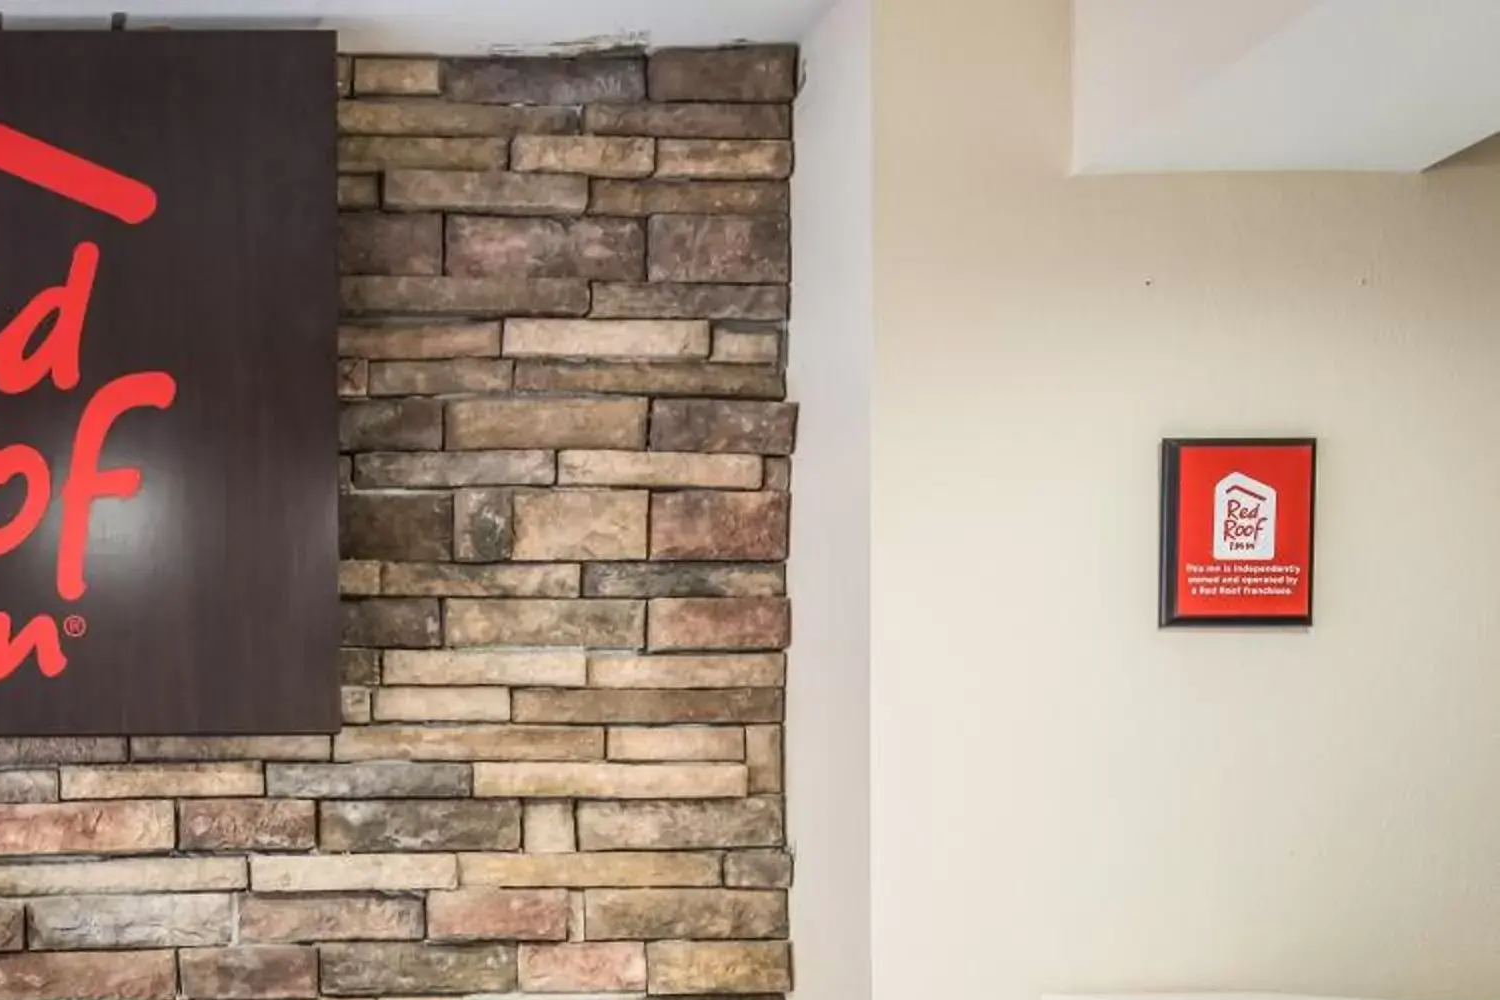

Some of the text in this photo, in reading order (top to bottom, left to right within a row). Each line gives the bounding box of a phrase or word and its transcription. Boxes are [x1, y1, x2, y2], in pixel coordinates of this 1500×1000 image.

[1227, 499, 1260, 520] Red
[1223, 518, 1268, 542] Roof
[1233, 564, 1300, 575] independently
[1187, 576, 1299, 585] owned and operated by
[1199, 586, 1217, 595] Red
[1219, 586, 1241, 595] Roof
